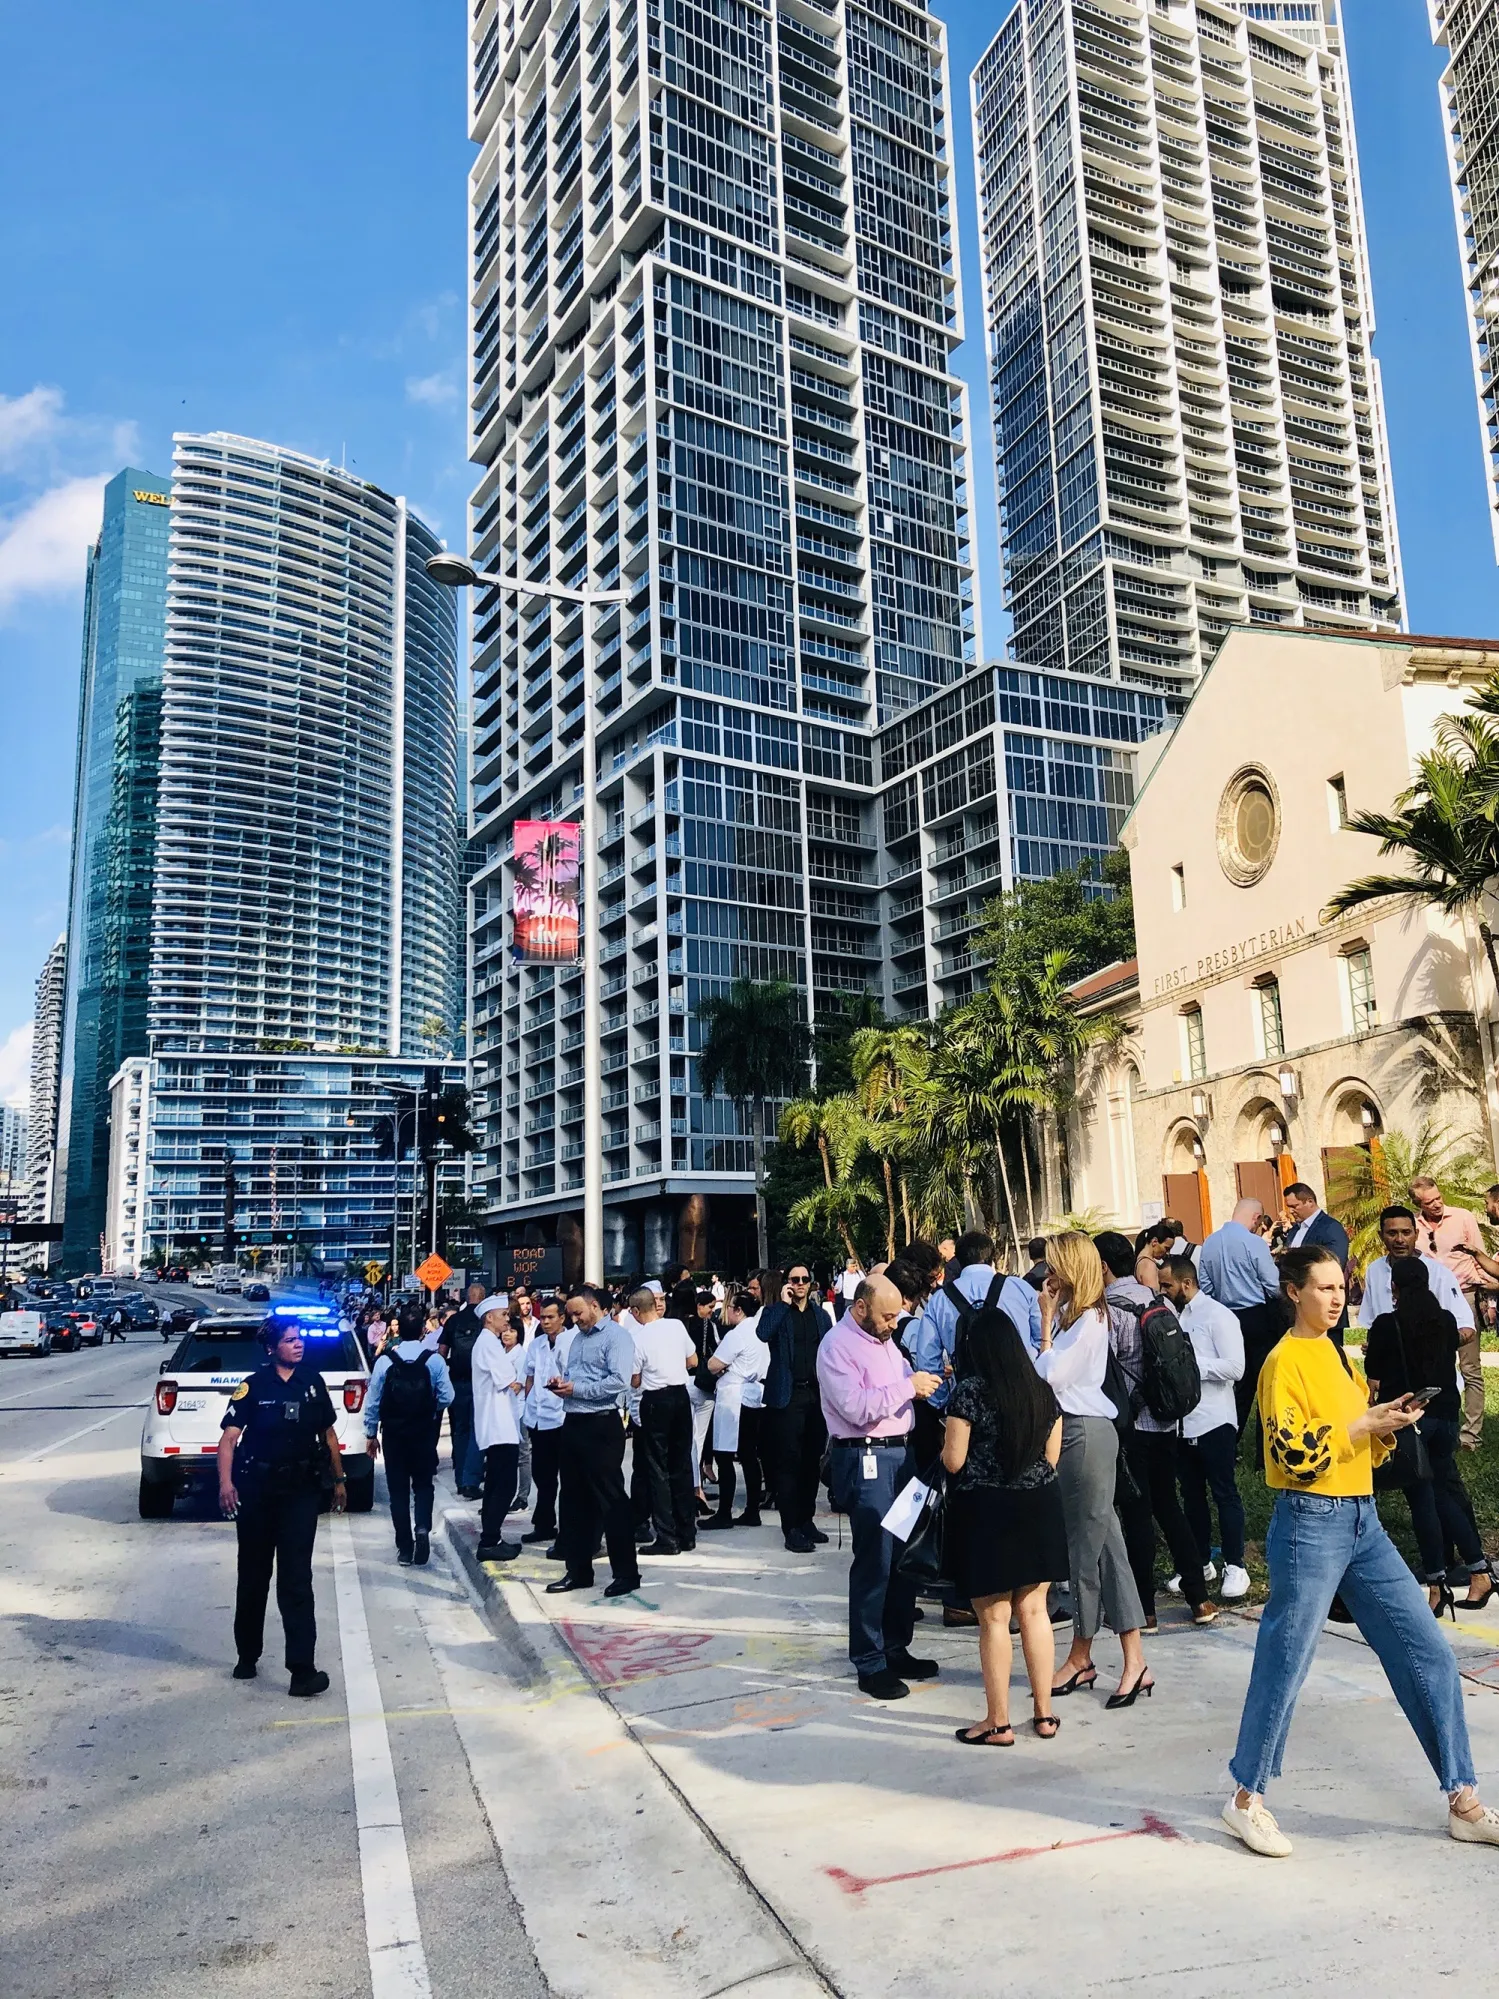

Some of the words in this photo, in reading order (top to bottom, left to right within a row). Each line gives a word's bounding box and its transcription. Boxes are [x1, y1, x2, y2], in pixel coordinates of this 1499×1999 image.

[1154, 966, 1187, 993] FIRST
[1197, 916, 1305, 977] PRESBYTERIAN
[513, 1247, 546, 1259] ROAD
[513, 1261, 538, 1272] WOR
[178, 1400, 206, 1409] 216432
